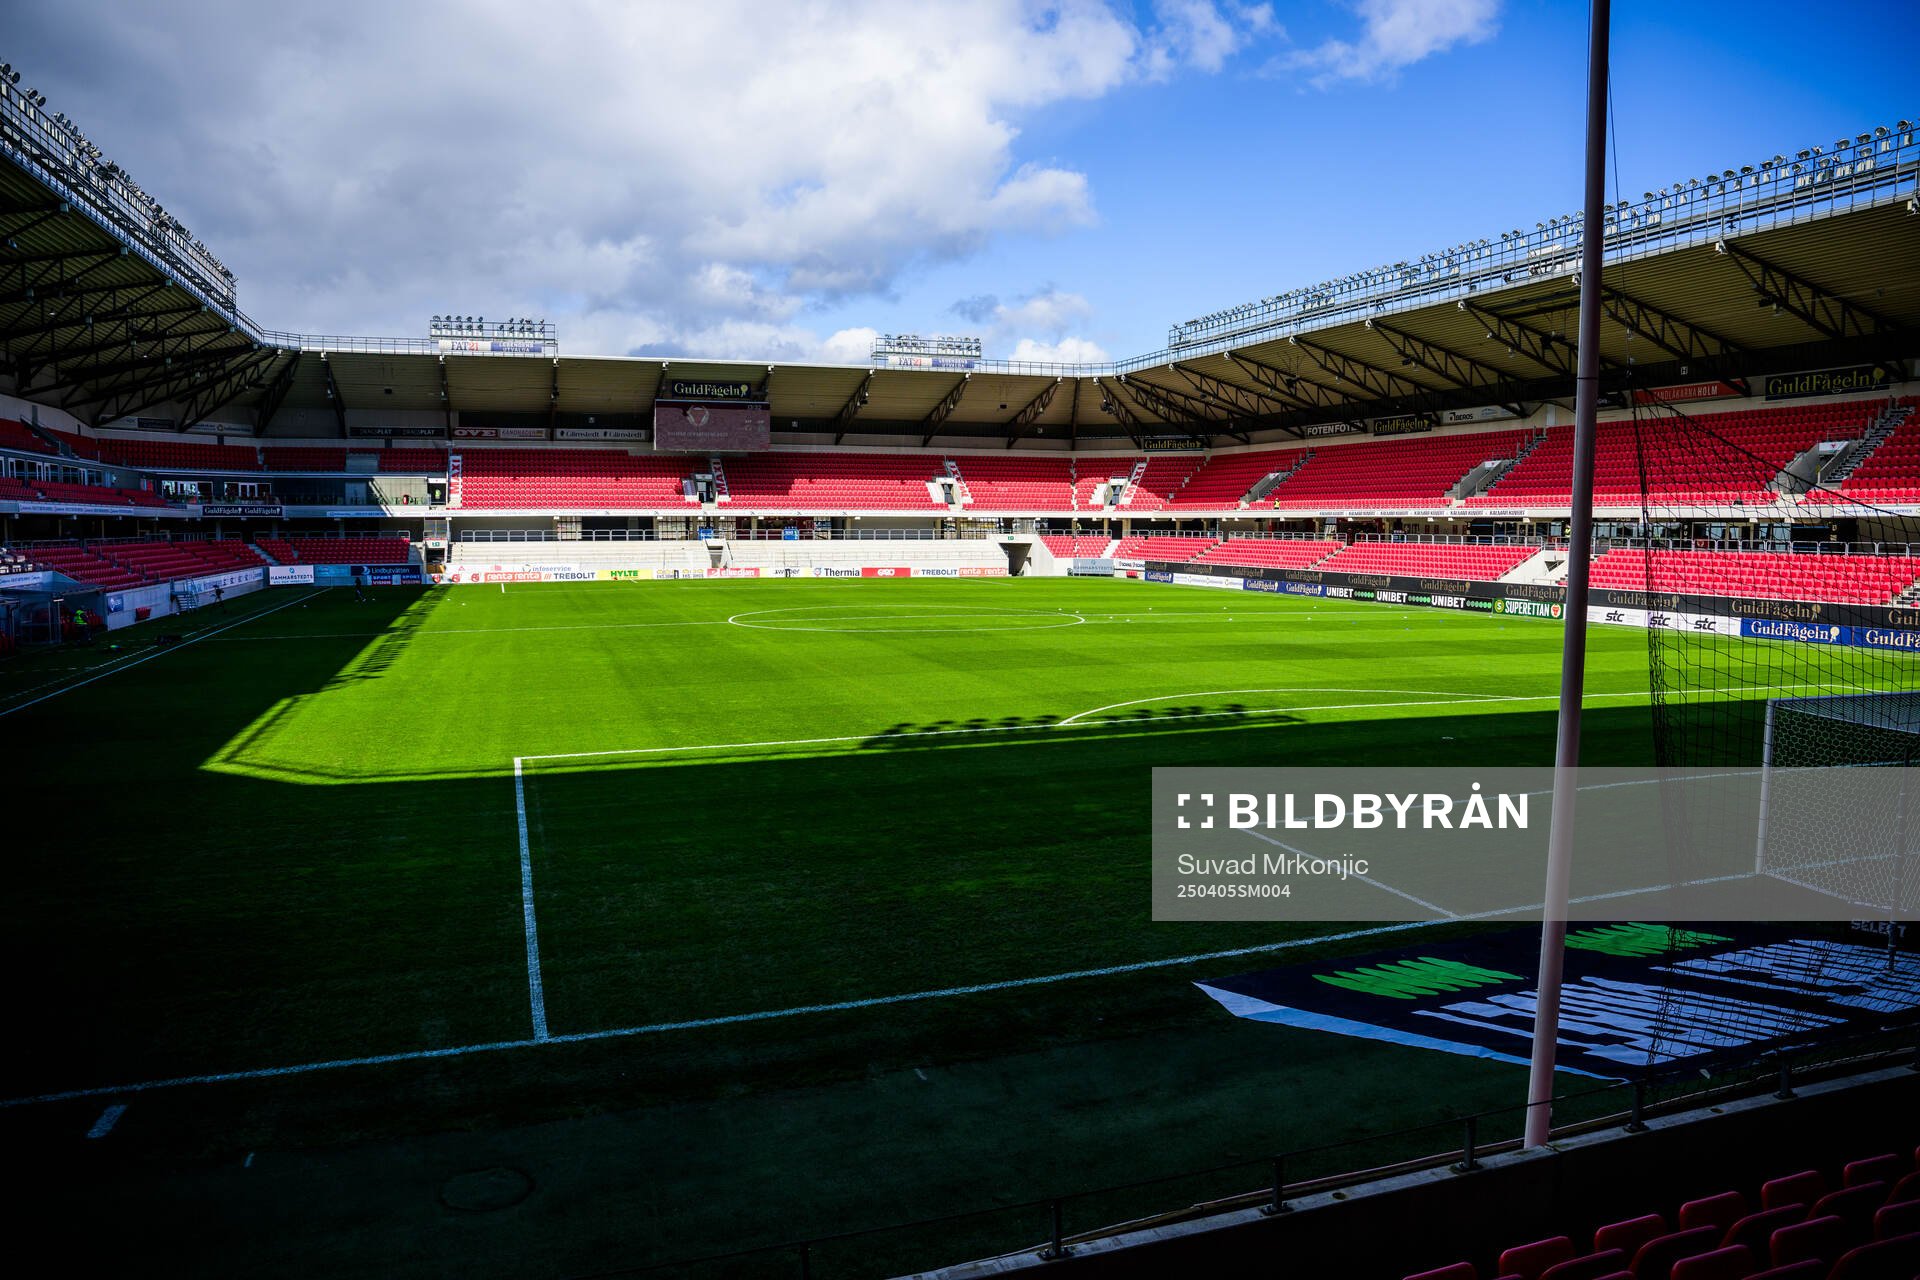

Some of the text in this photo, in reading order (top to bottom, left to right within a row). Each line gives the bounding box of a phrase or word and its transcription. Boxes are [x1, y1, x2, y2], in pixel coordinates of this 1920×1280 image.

[1769, 370, 1870, 395] GuldFågeln
[674, 383, 740, 398] GuldFågeln
[453, 429, 498, 438] OVE
[450, 459, 461, 494] MAXI
[553, 572, 595, 580] TREBOLIT
[824, 568, 860, 577] Thermia
[1326, 587, 1353, 598] UNIBET
[1421, 579, 1465, 593] GuldFågeln
[1506, 584, 1559, 600] GuldFågeln
[1377, 591, 1408, 603] UNIBET
[1431, 595, 1466, 608] UNIBET
[1505, 600, 1550, 617] SUPERETTAN
[1732, 599, 1811, 619] GuldFågeln
[1605, 610, 1625, 623] stc
[1694, 618, 1717, 633] stc
[1751, 621, 1829, 642] GuldFågeln
